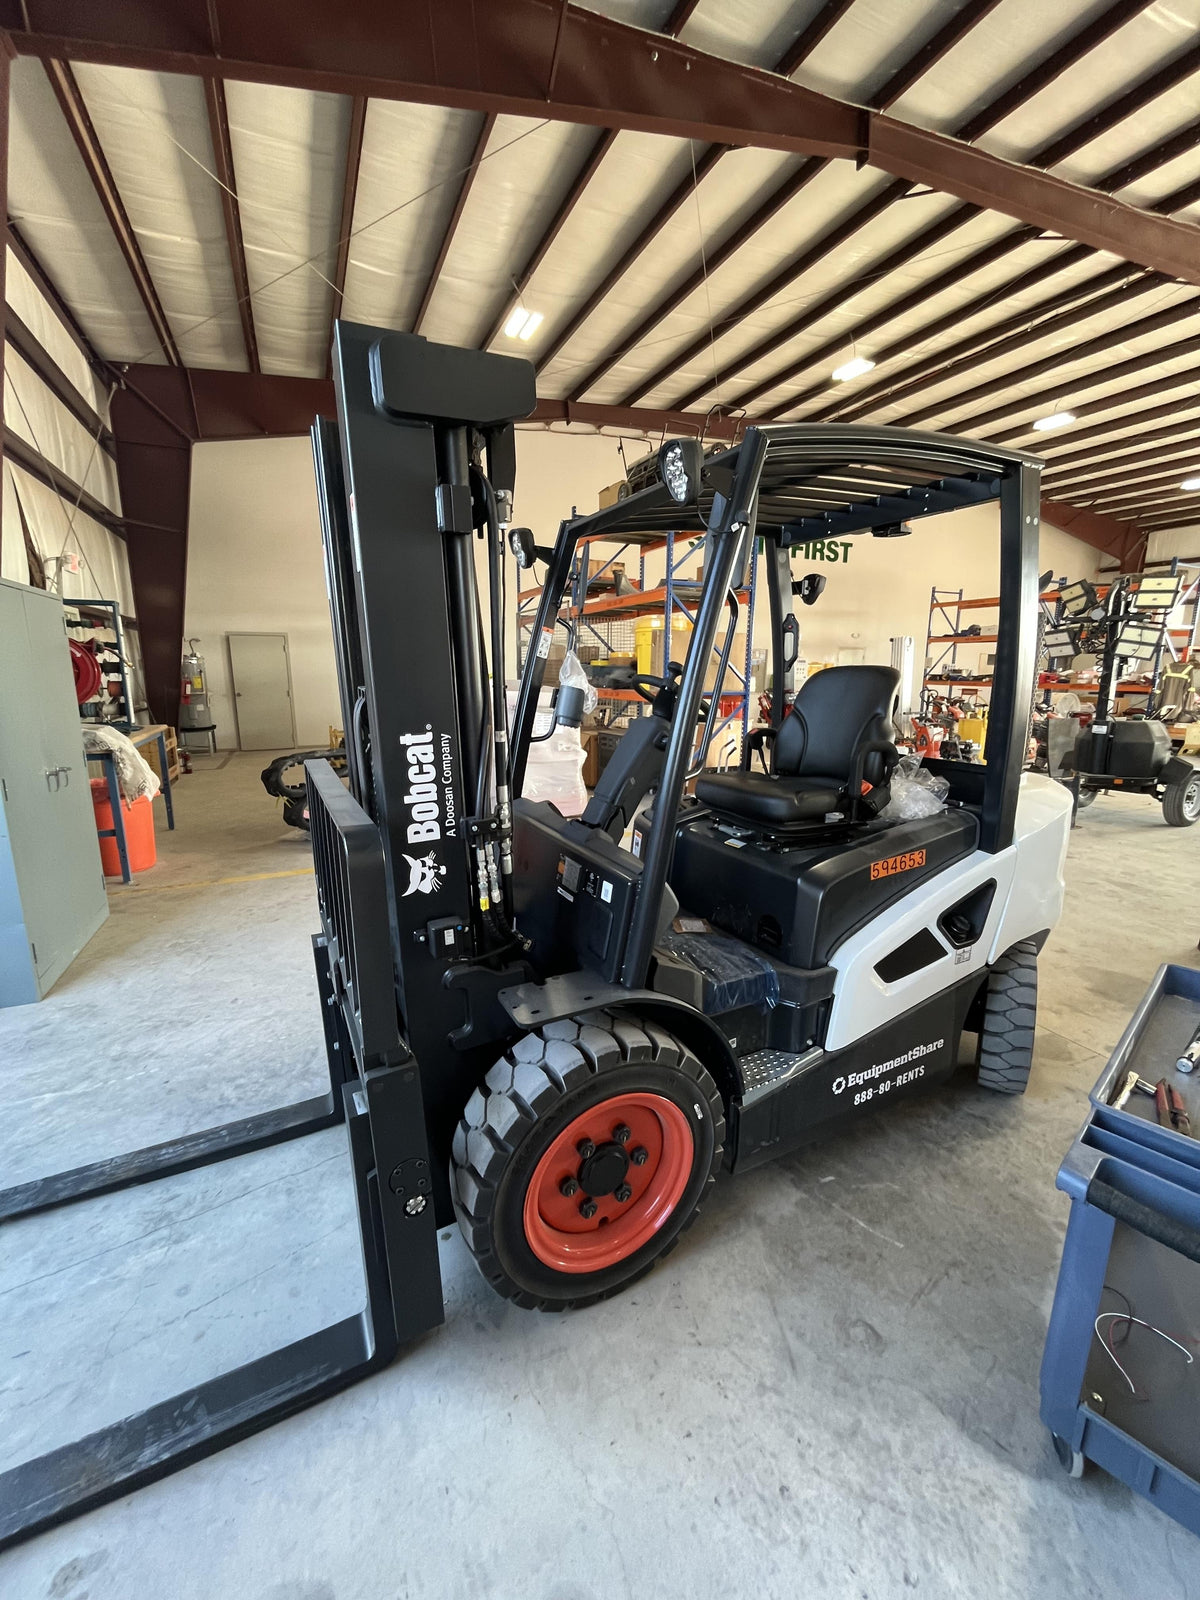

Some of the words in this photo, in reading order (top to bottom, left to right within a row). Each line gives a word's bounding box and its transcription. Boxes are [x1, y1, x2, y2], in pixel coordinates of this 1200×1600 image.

[791, 540, 853, 563] FIRST
[441, 733, 452, 784] Company
[400, 732, 440, 844] Bobcat
[445, 786, 455, 827] Doosan
[446, 829, 456, 837] A
[872, 850, 925, 879] 594653
[847, 1038, 944, 1085] EquipmentShare
[853, 1065, 925, 1106] 888-80-RENTS
